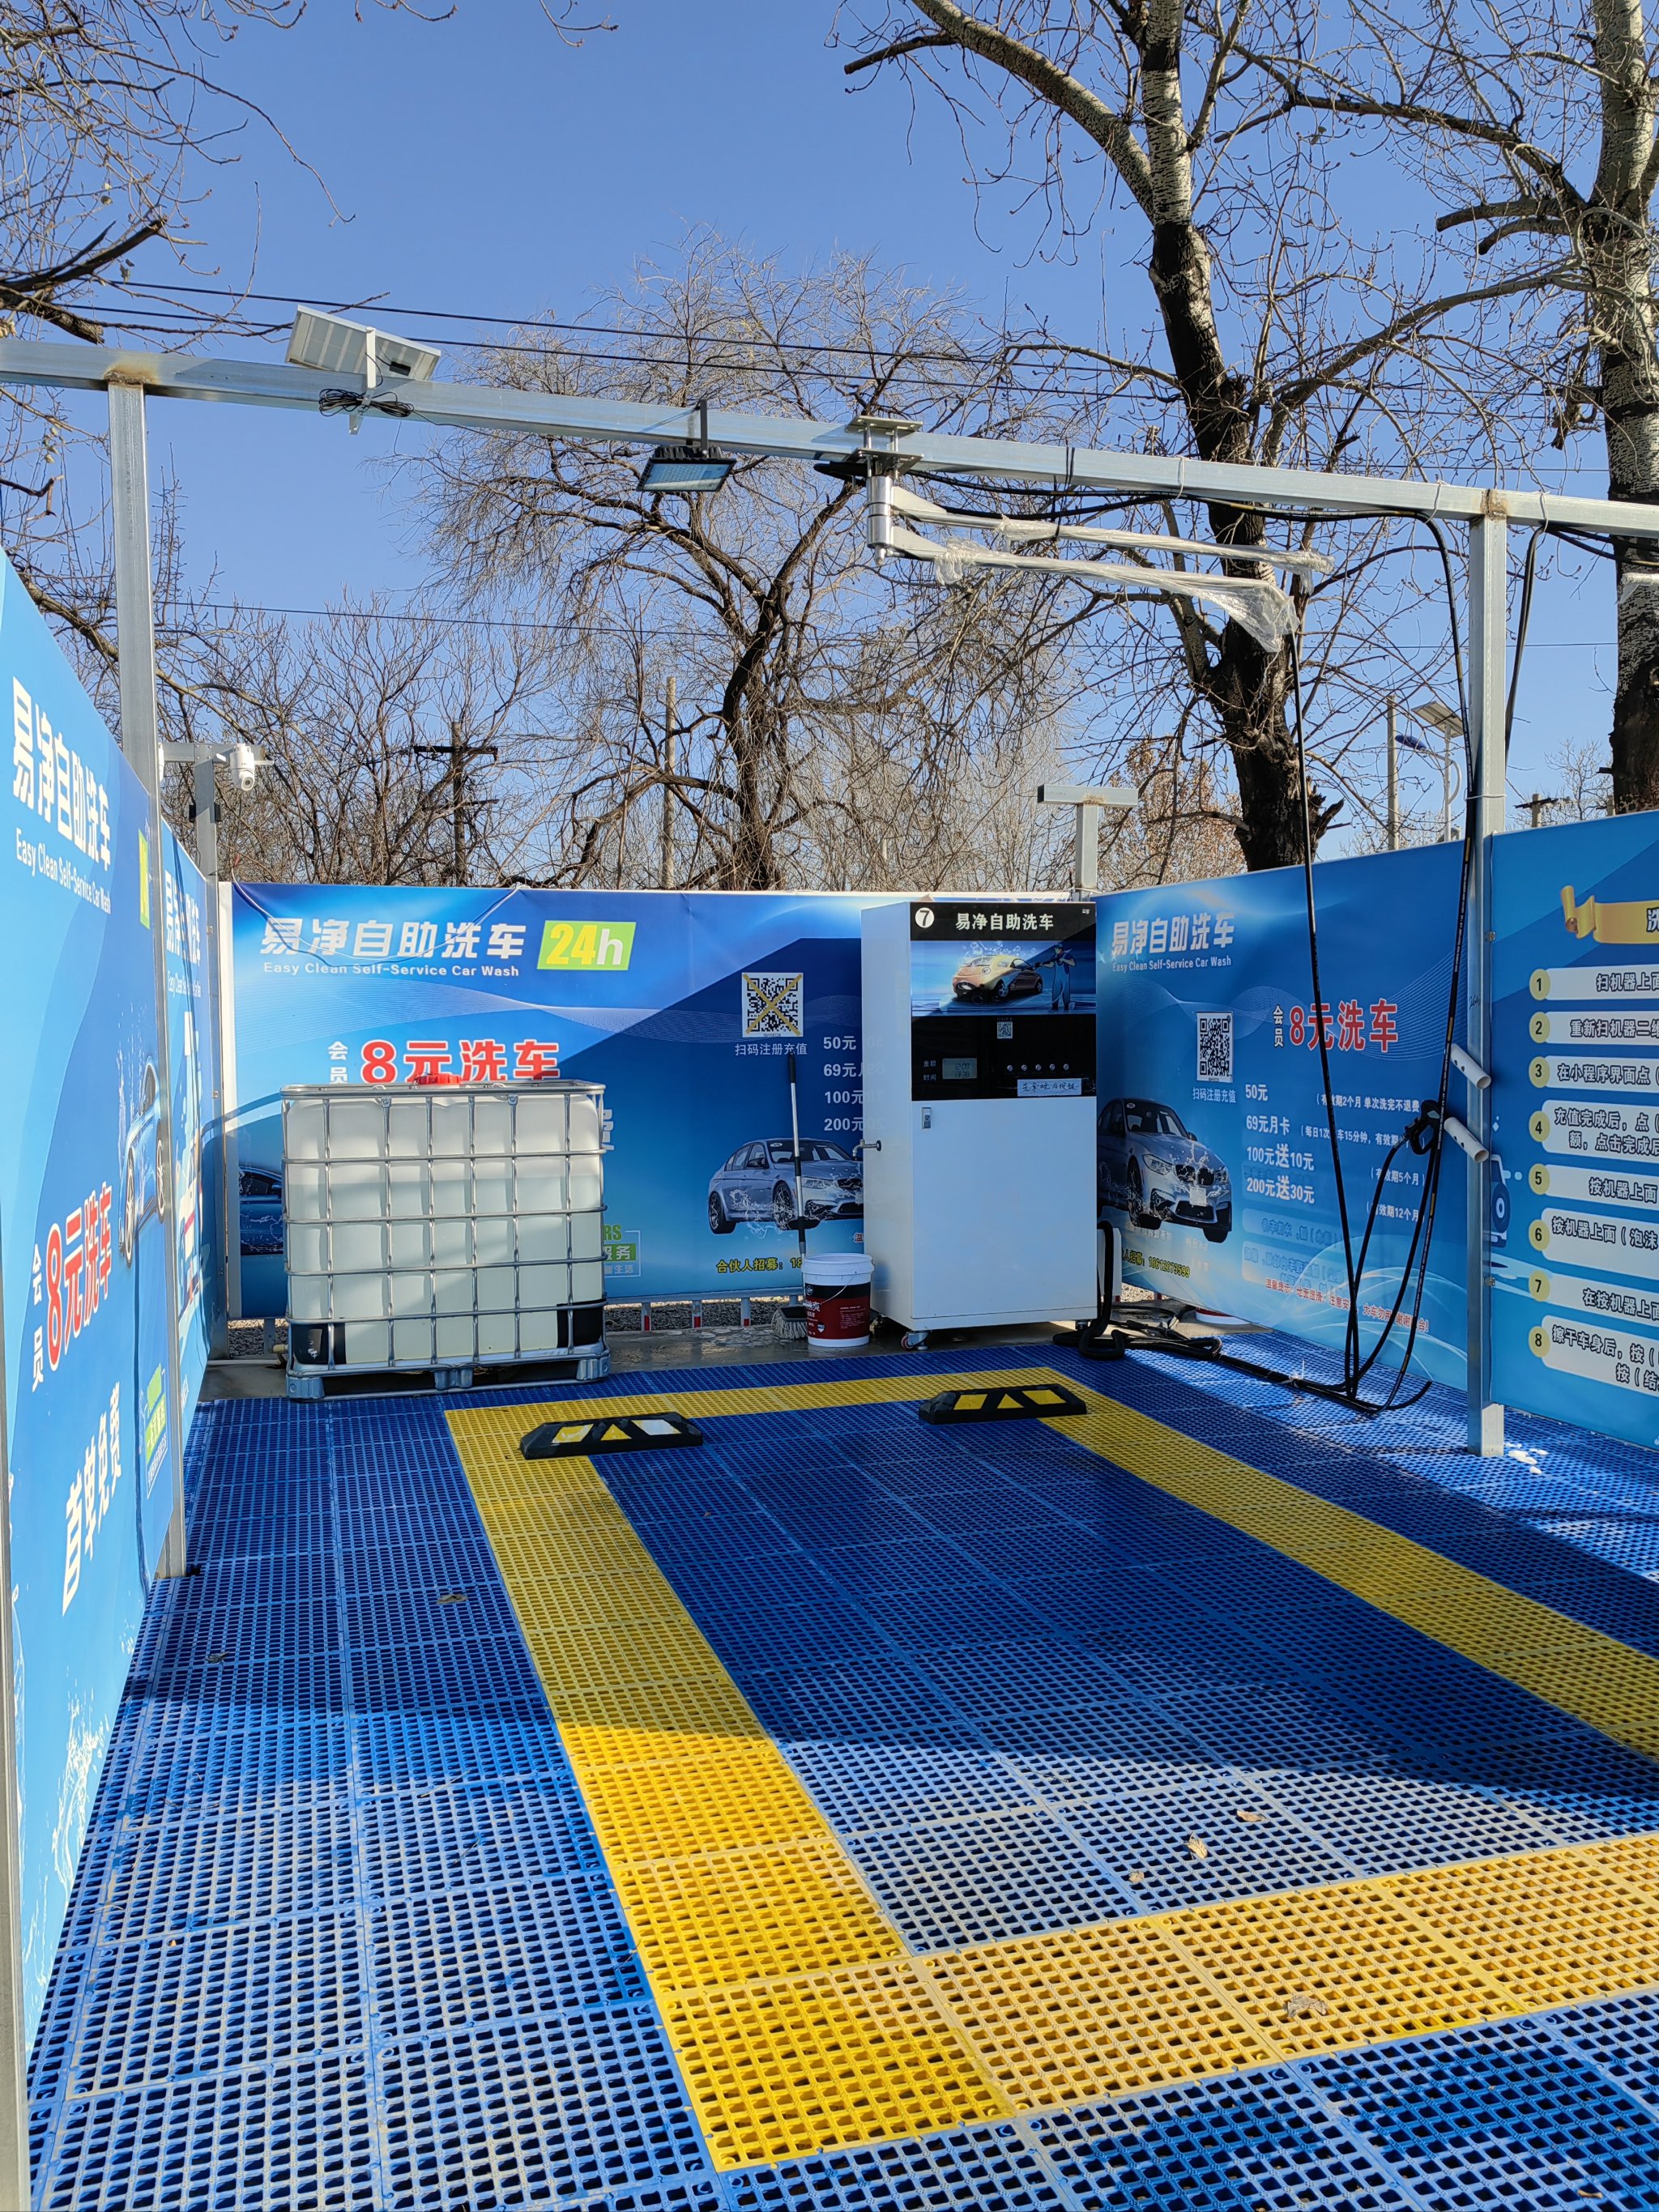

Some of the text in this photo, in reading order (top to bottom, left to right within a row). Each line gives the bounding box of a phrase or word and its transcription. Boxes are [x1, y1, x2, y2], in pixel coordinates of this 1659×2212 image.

[13, 676, 111, 872] 易净自助洗车
[16, 827, 36, 877] Easy
[38, 842, 58, 881] Clean
[58, 855, 92, 903] Self-Service
[919, 910, 931, 927] 7
[955, 912, 1055, 931] 易净自助洗车
[260, 917, 527, 959] 易净自助洗车
[545, 923, 625, 967] 24h
[1111, 912, 1236, 957] 易净自助洗车
[264, 961, 519, 978] Easy Clean Self-Service Car Wash
[1113, 954, 1231, 974] Easy Clean Self-Service Car Wash
[1536, 978, 1542, 992] 1
[1273, 1005, 1284, 1048] 会员
[1290, 997, 1398, 1054] 8元洗车
[1535, 1021, 1543, 1035] 2
[735, 1042, 808, 1055] 扫码注册充值
[823, 1036, 857, 1051] 50元
[327, 1041, 348, 1083] 会员
[360, 1038, 561, 1083] 8元洗车
[823, 1063, 863, 1078] 69元
[1535, 1063, 1542, 1078] 3
[1192, 1086, 1236, 1103] 扫码注册充值
[1245, 1084, 1269, 1102] 50元
[1246, 1115, 1290, 1136] 69元月卡
[1535, 1120, 1542, 1135] 4
[1247, 1143, 1315, 1171] 100元送10元
[1247, 1175, 1315, 1204] 200元送30元
[1535, 1171, 1658, 1204] 5 按机器上面
[1535, 1228, 1542, 1242] 6
[45, 1181, 113, 1372] 8元洗车
[716, 1257, 783, 1274] 合伙人招募：
[1535, 1279, 1542, 1294] 7
[31, 1242, 44, 1392] 会员
[1535, 1325, 1659, 1366] 8 擦干车身后，按（
[1615, 1363, 1659, 1392] 按（结
[62, 1381, 122, 1617] 首单免费
